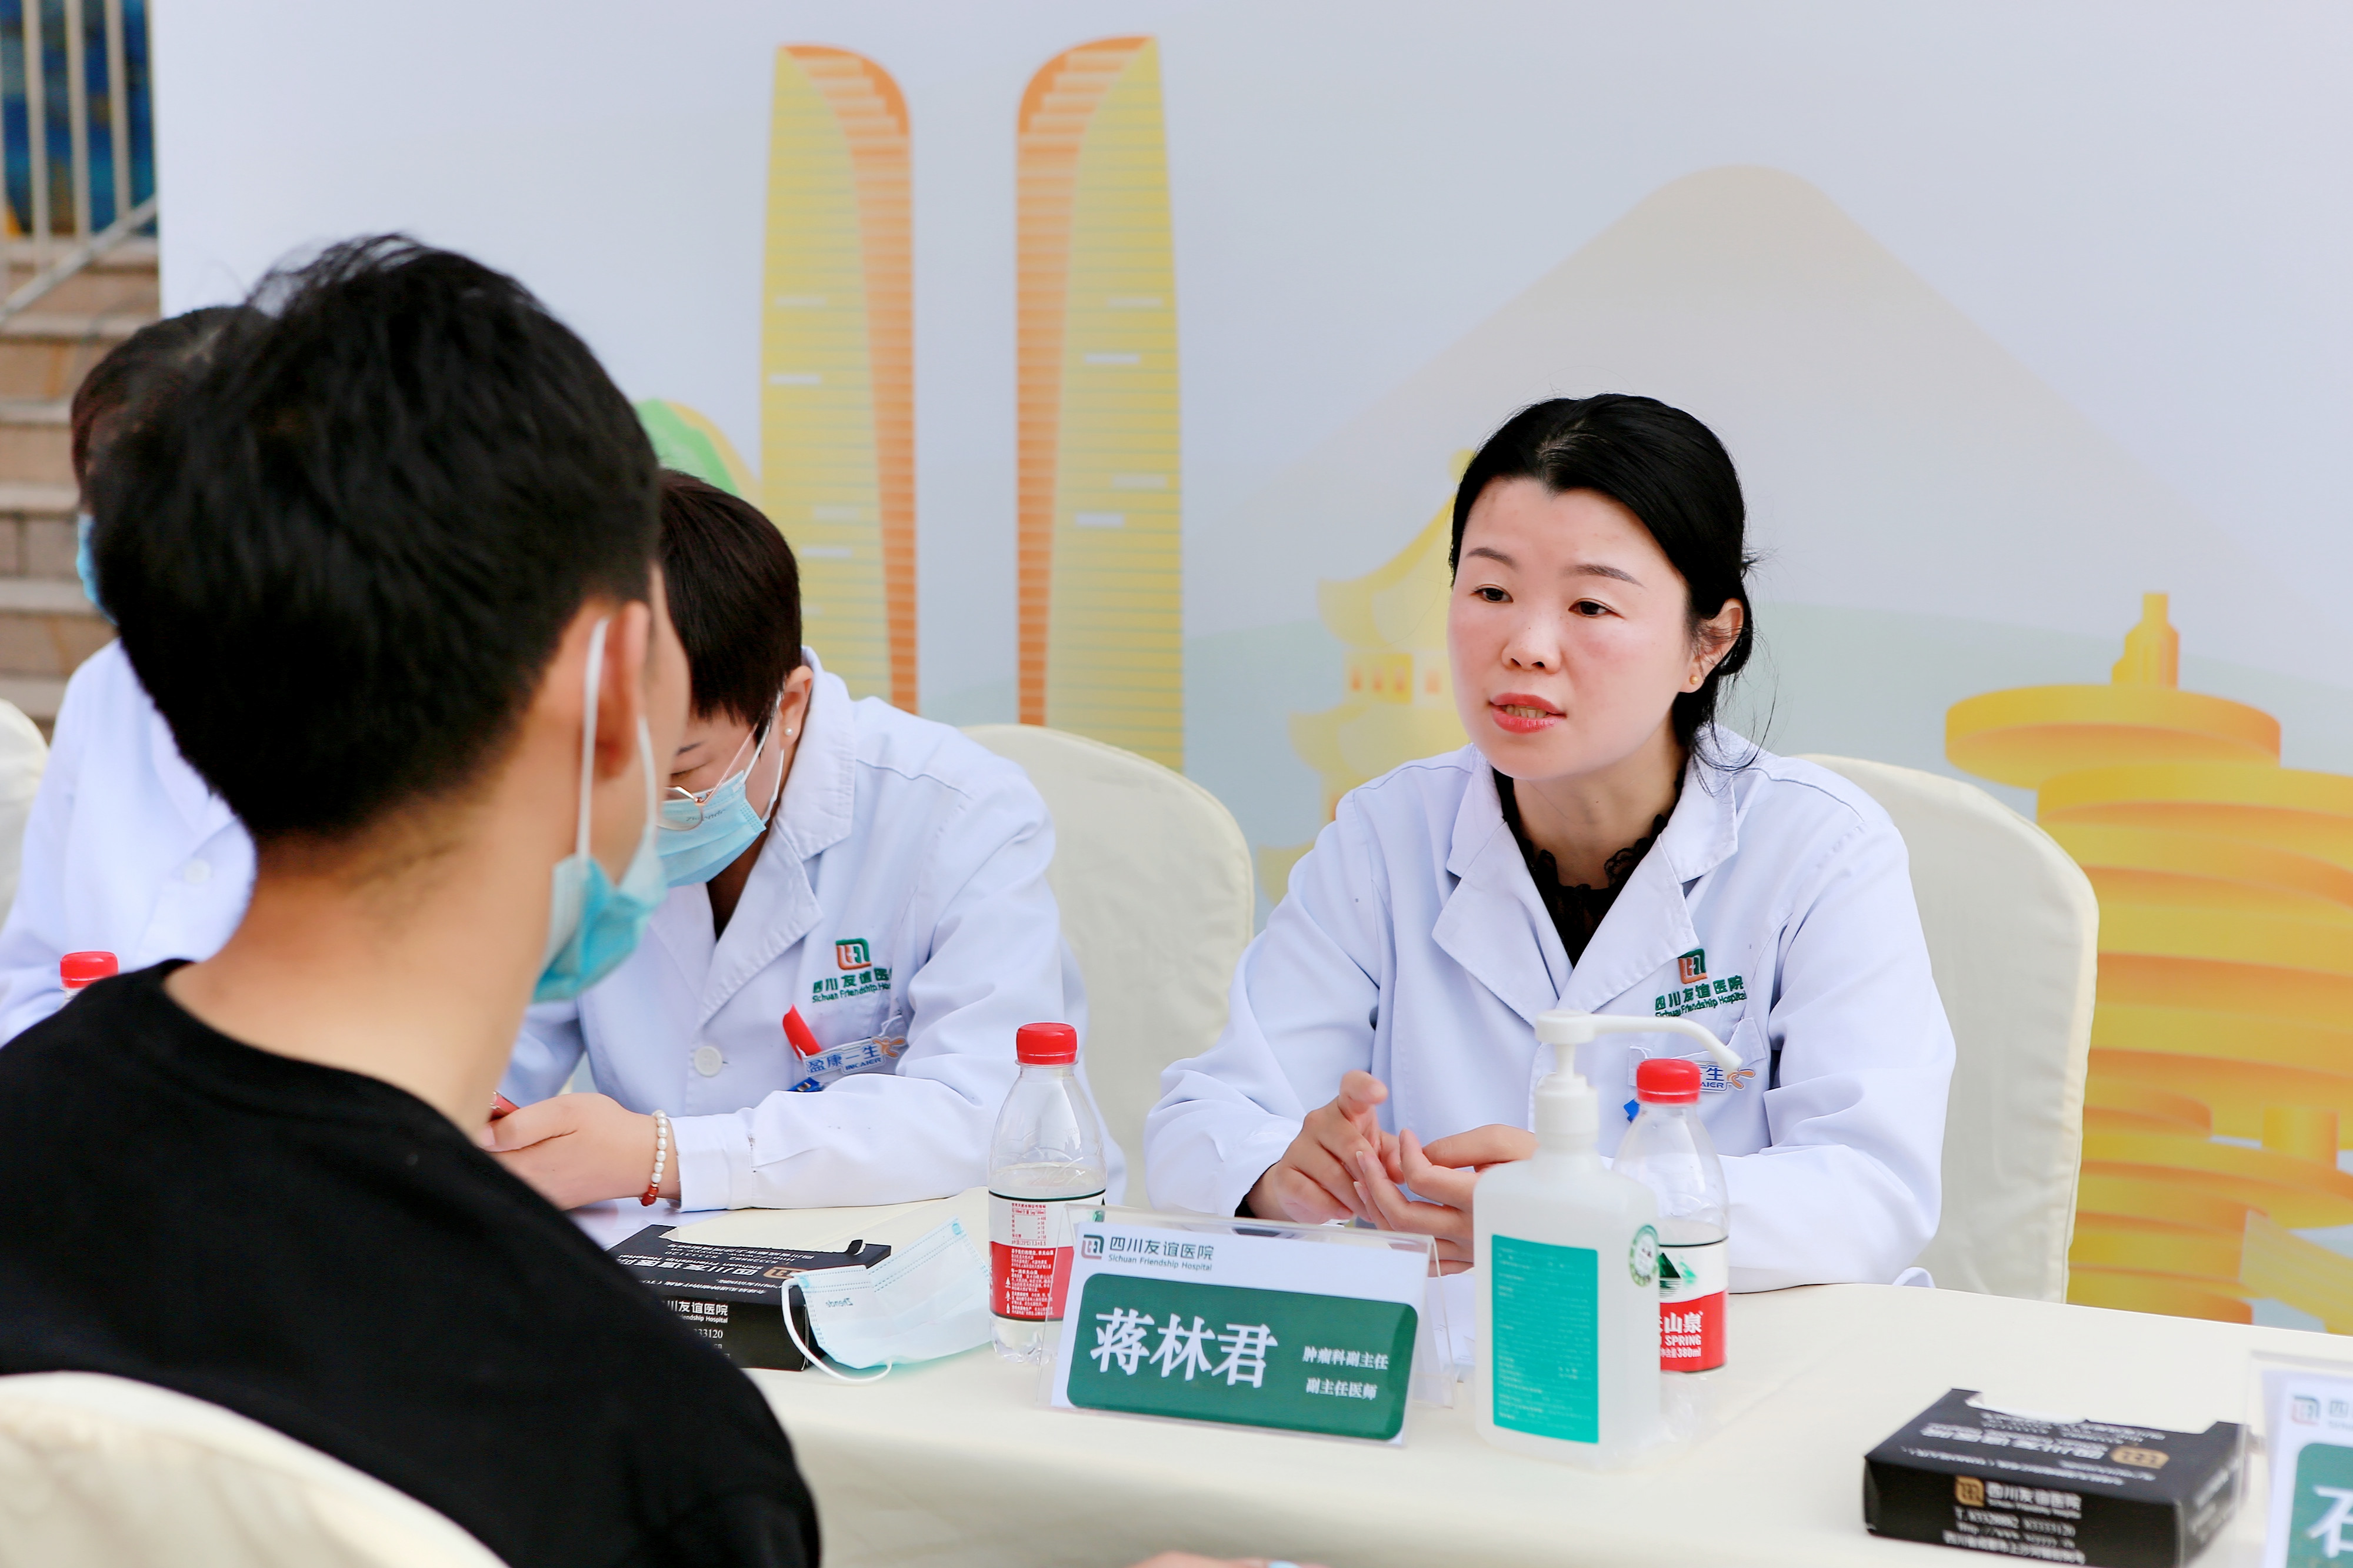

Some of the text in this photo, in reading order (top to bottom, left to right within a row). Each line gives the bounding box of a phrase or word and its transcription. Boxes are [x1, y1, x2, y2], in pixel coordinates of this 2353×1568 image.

[1655, 975, 1744, 1011] 四川友谊医院
[808, 1043, 881, 1073] 盈康一生
[1109, 1236, 1214, 1260] 四川友谊医院
[1108, 1254, 1212, 1272] Sichuan Friendship Hospital
[662, 1300, 728, 1316] 川友谊医院
[705, 1316, 729, 1324] Hospital
[1659, 1310, 1702, 1333] 山泉
[1090, 1307, 1278, 1389] 蒋林君
[1664, 1334, 1702, 1346] SPRING
[1302, 1345, 1389, 1370] 肿瘤科副主任
[1306, 1377, 1378, 1401] 副主任医师
